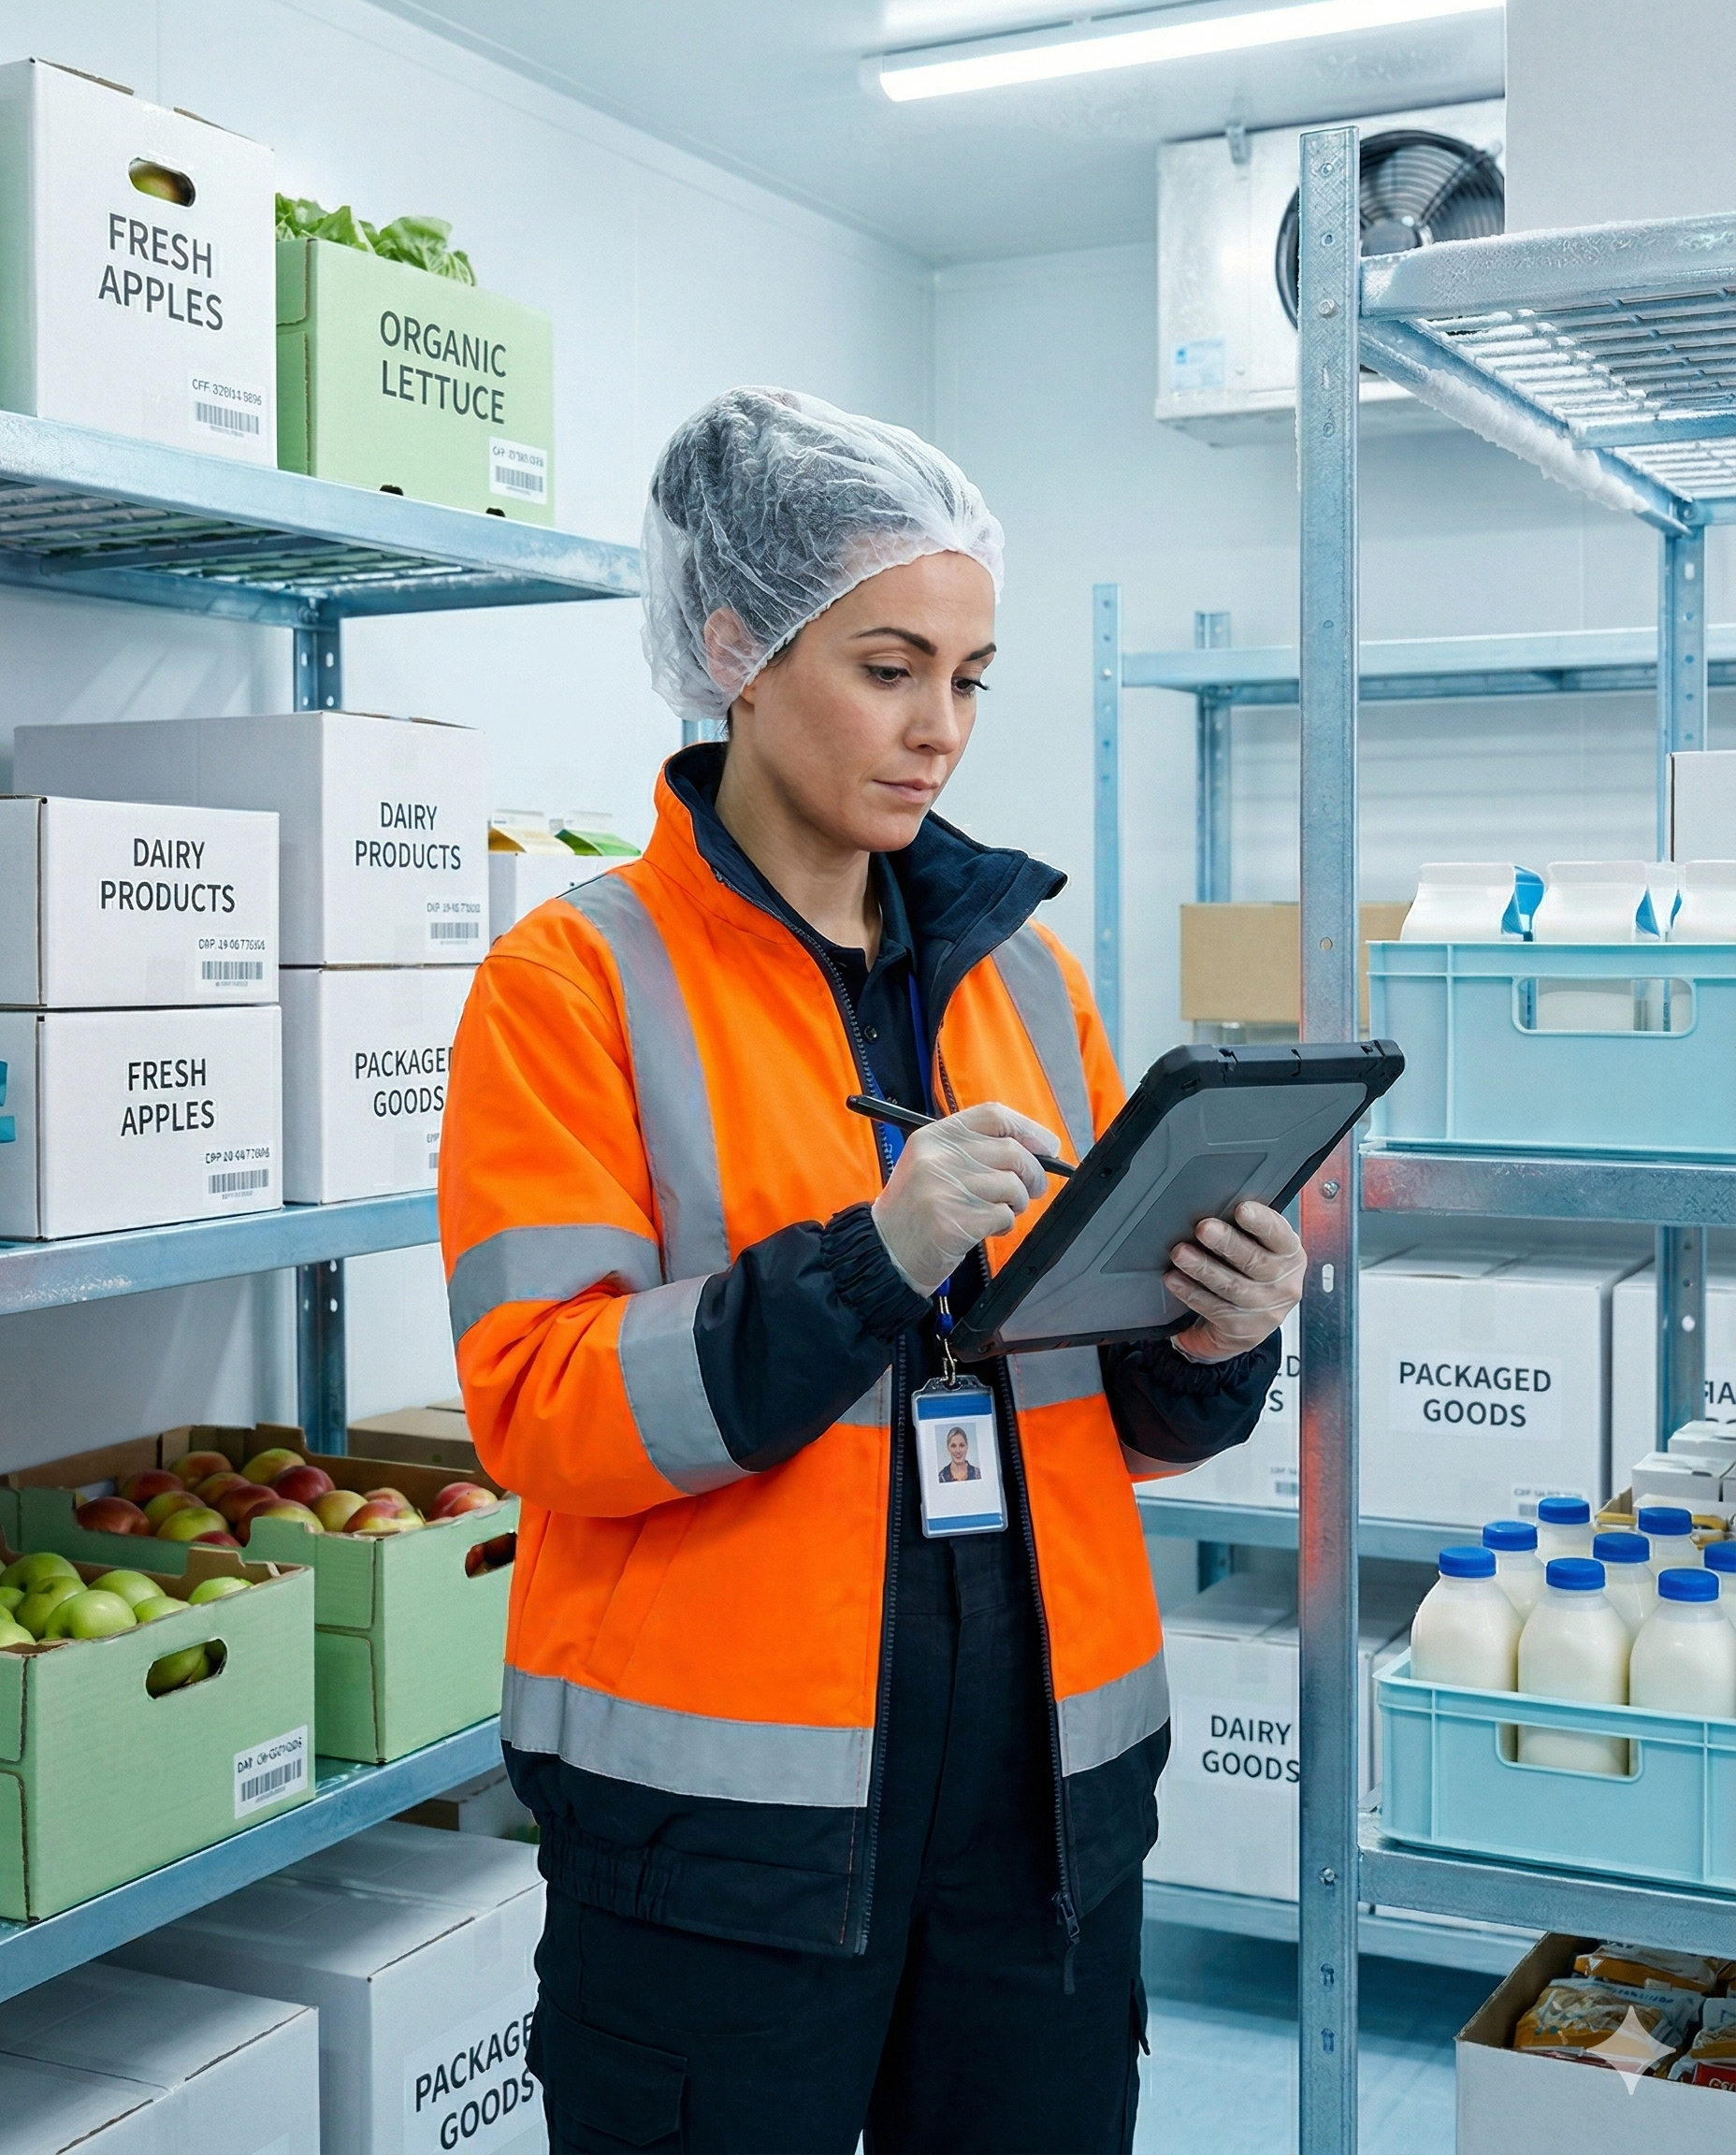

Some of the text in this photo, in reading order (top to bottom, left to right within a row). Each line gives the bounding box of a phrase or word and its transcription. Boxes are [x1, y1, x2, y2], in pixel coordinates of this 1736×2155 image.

[108, 212, 211, 278] FRESH
[97, 264, 224, 331] APPLES
[380, 311, 507, 378] ORGANIC
[382, 359, 505, 425] LETTUCE
[381, 802, 438, 831] DAIRY
[134, 837, 205, 870] DAIRY
[355, 839, 461, 871] PRODUCTS
[101, 880, 236, 914] PRODUCTS
[128, 1058, 206, 1092] FRESH
[121, 1099, 214, 1136] APPLES
[373, 1085, 444, 1118] GOODS
[1399, 1361, 1551, 1393] PACKAGED
[1424, 1398, 1526, 1428] GOODS
[1211, 1714, 1292, 1745] DAIRY
[1202, 1749, 1299, 1784] GOODS
[441, 2066, 534, 2150] GOODS
